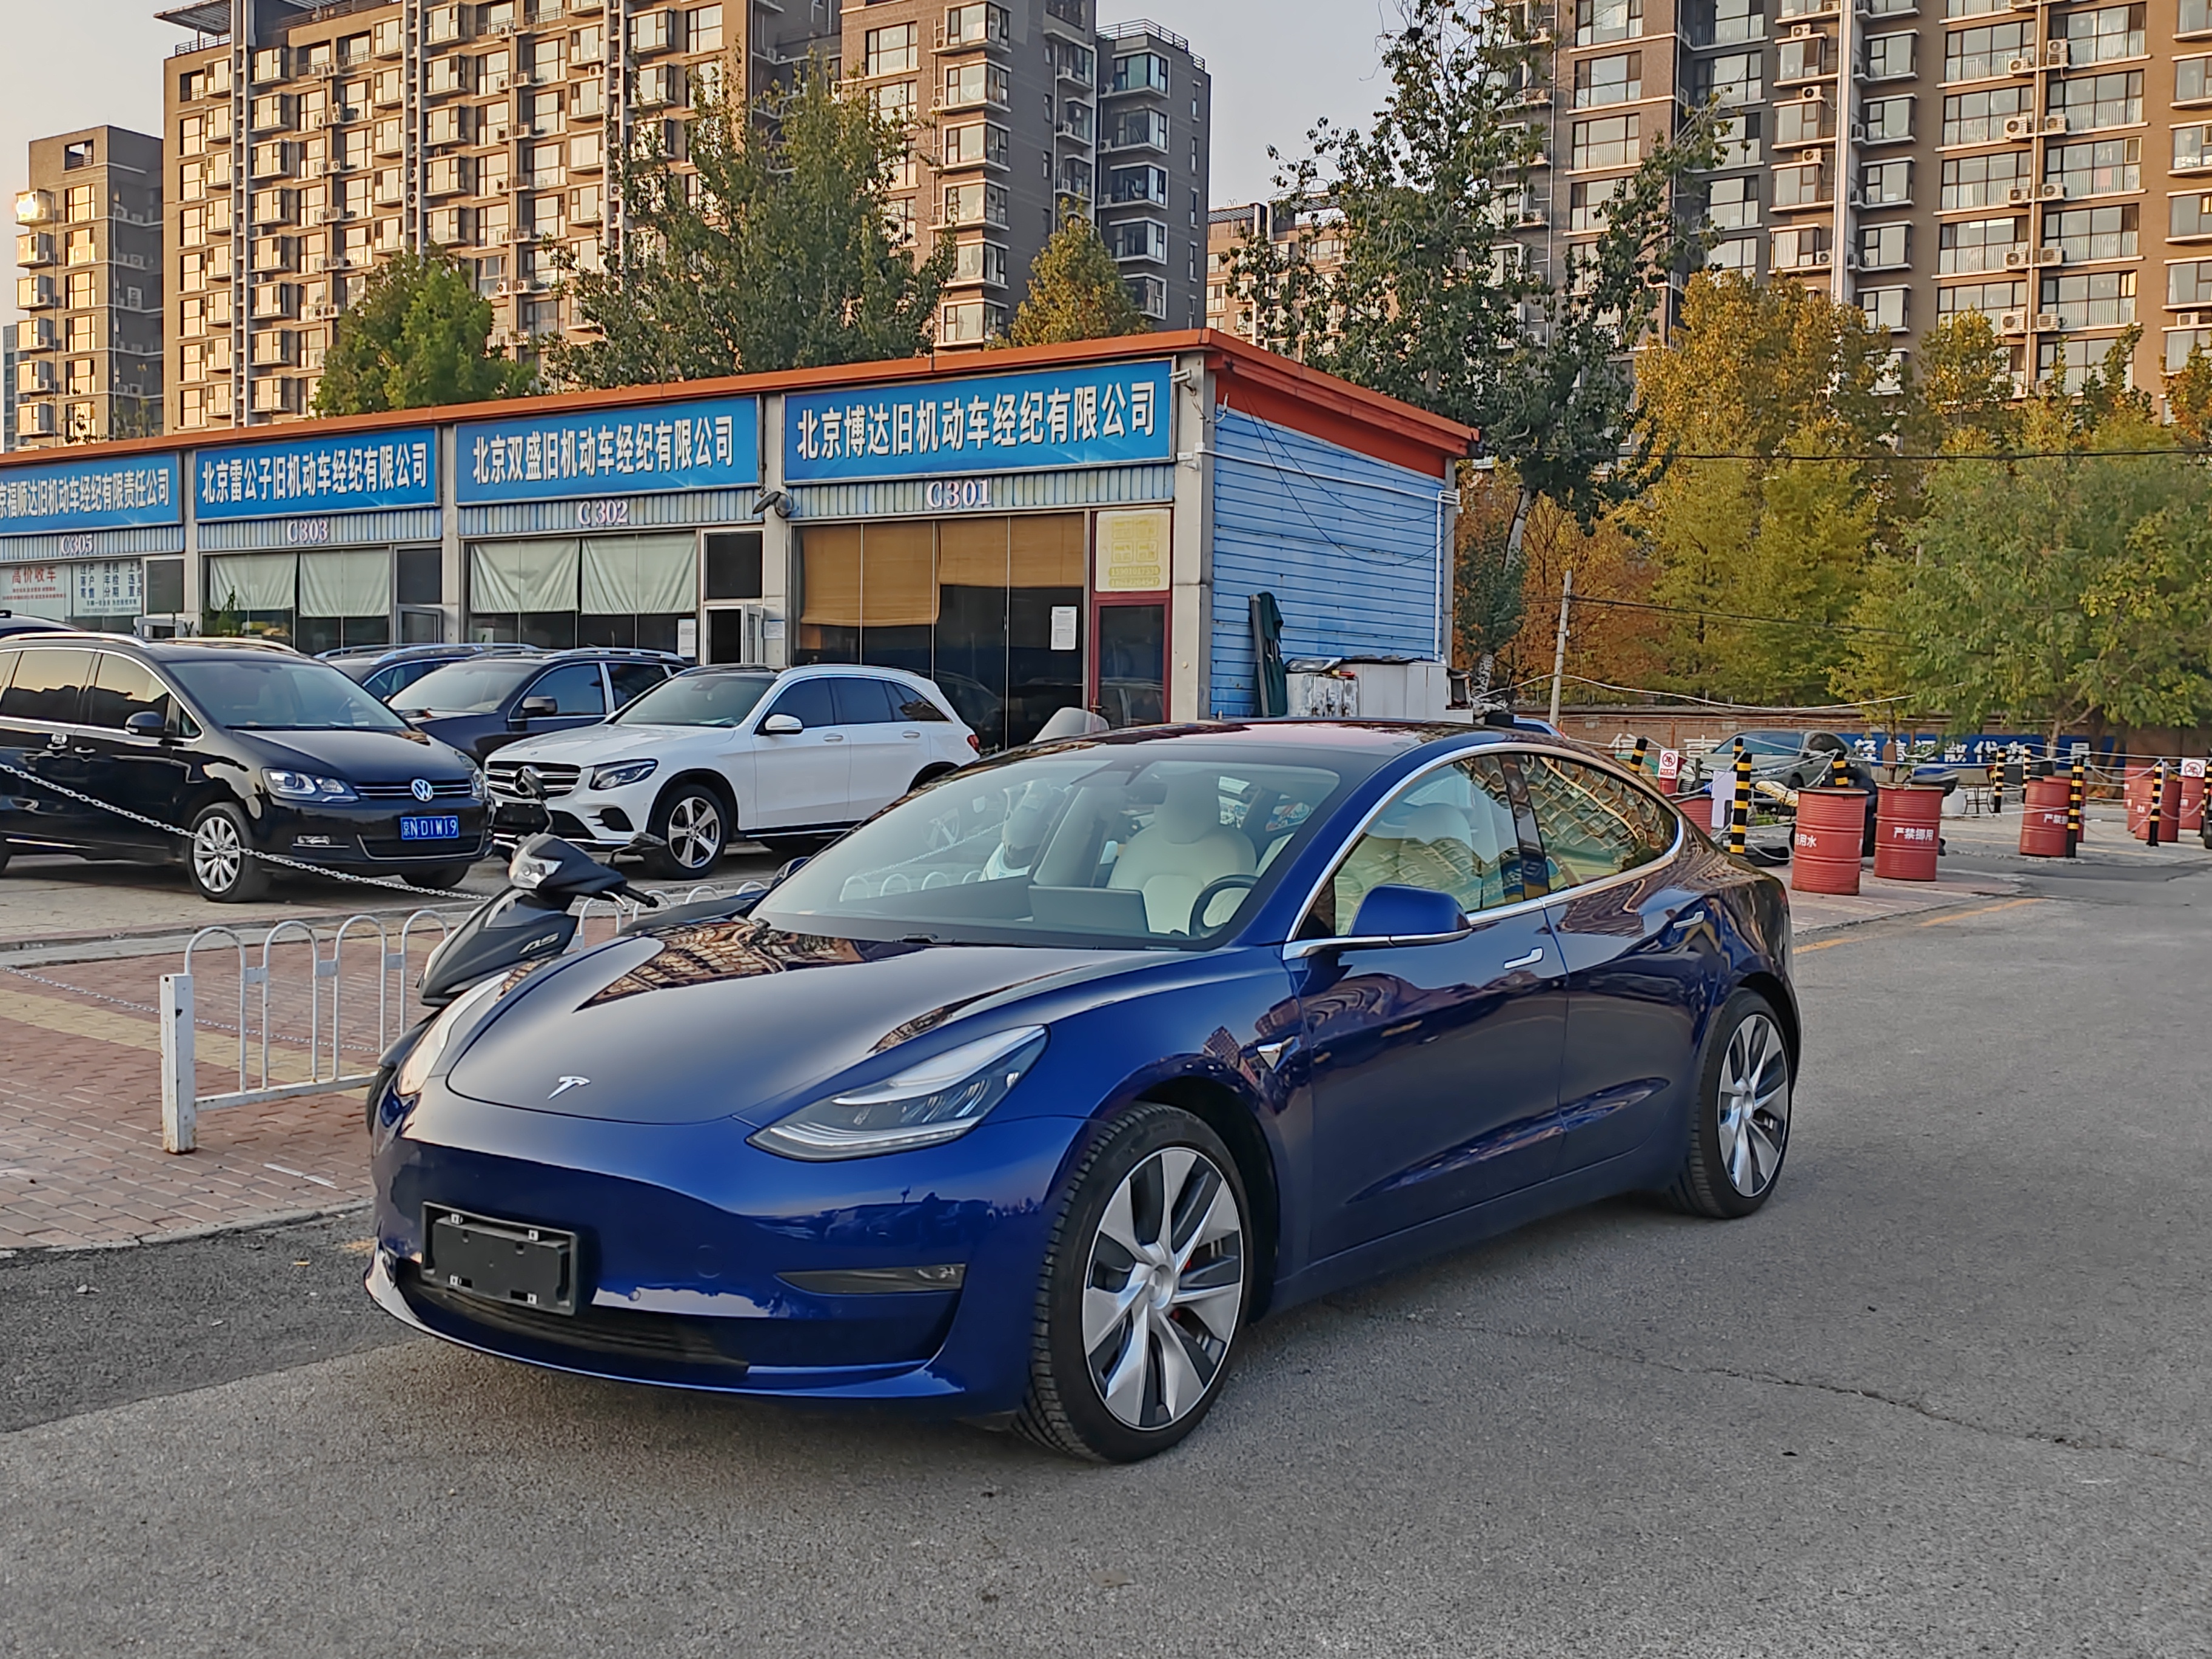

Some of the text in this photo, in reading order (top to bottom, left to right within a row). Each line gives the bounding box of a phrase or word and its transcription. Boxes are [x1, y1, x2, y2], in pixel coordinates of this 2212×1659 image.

[797, 381, 1156, 460] 北京博达旧机动车经纪有限公司
[473, 415, 734, 484] 北京双盛旧机动车经纪有限公司
[202, 443, 427, 504] 北京雷公子旧机动车经纪有限公司
[926, 478, 991, 509] C301
[61, 534, 93, 554] C305
[287, 520, 329, 542] C303
[12, 566, 57, 584] 高价收车
